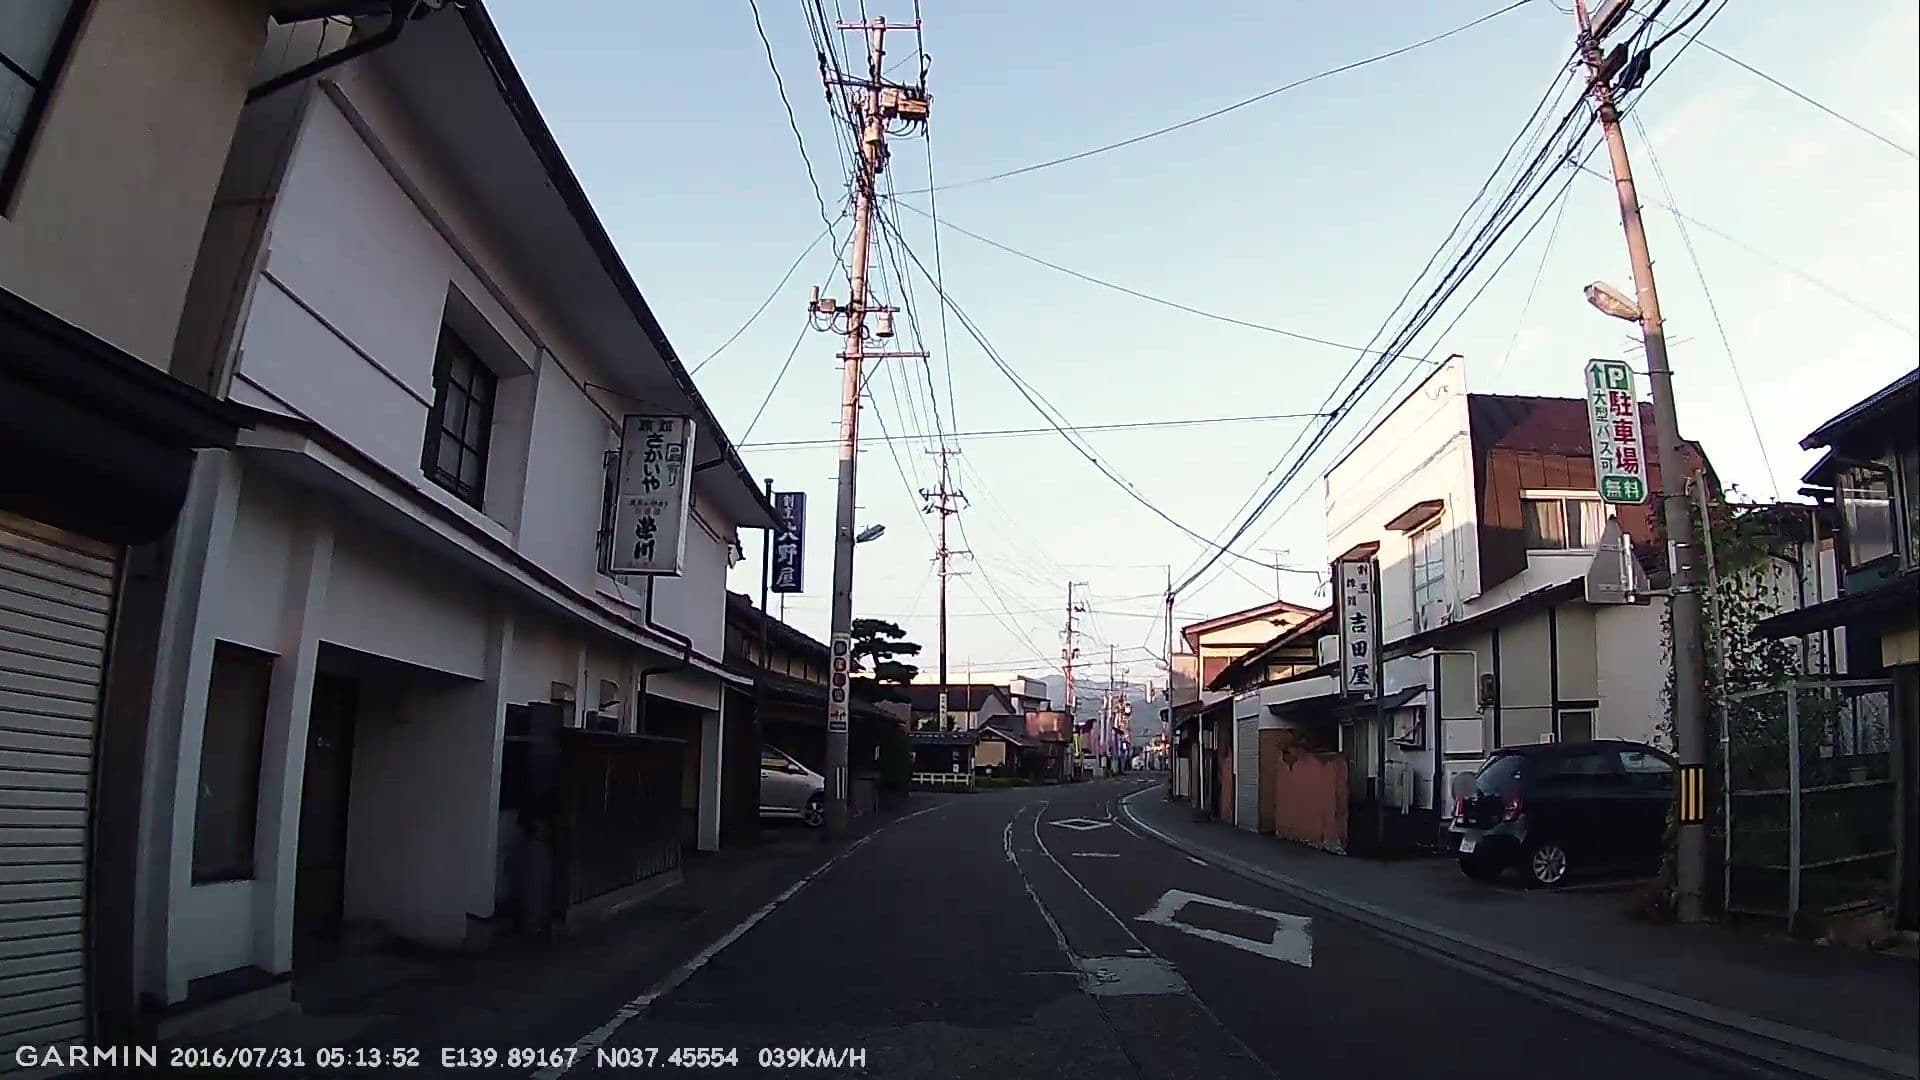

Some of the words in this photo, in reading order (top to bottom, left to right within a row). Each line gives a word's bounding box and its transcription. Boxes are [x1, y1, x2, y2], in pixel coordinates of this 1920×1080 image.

[1608, 367, 1626, 389] P
[641, 432, 664, 493] さかいや
[1593, 389, 1613, 474] 大型バス可
[1609, 391, 1639, 475] 駐車場
[1604, 479, 1640, 500] 無料
[1349, 611, 1370, 686] 吉田屋
